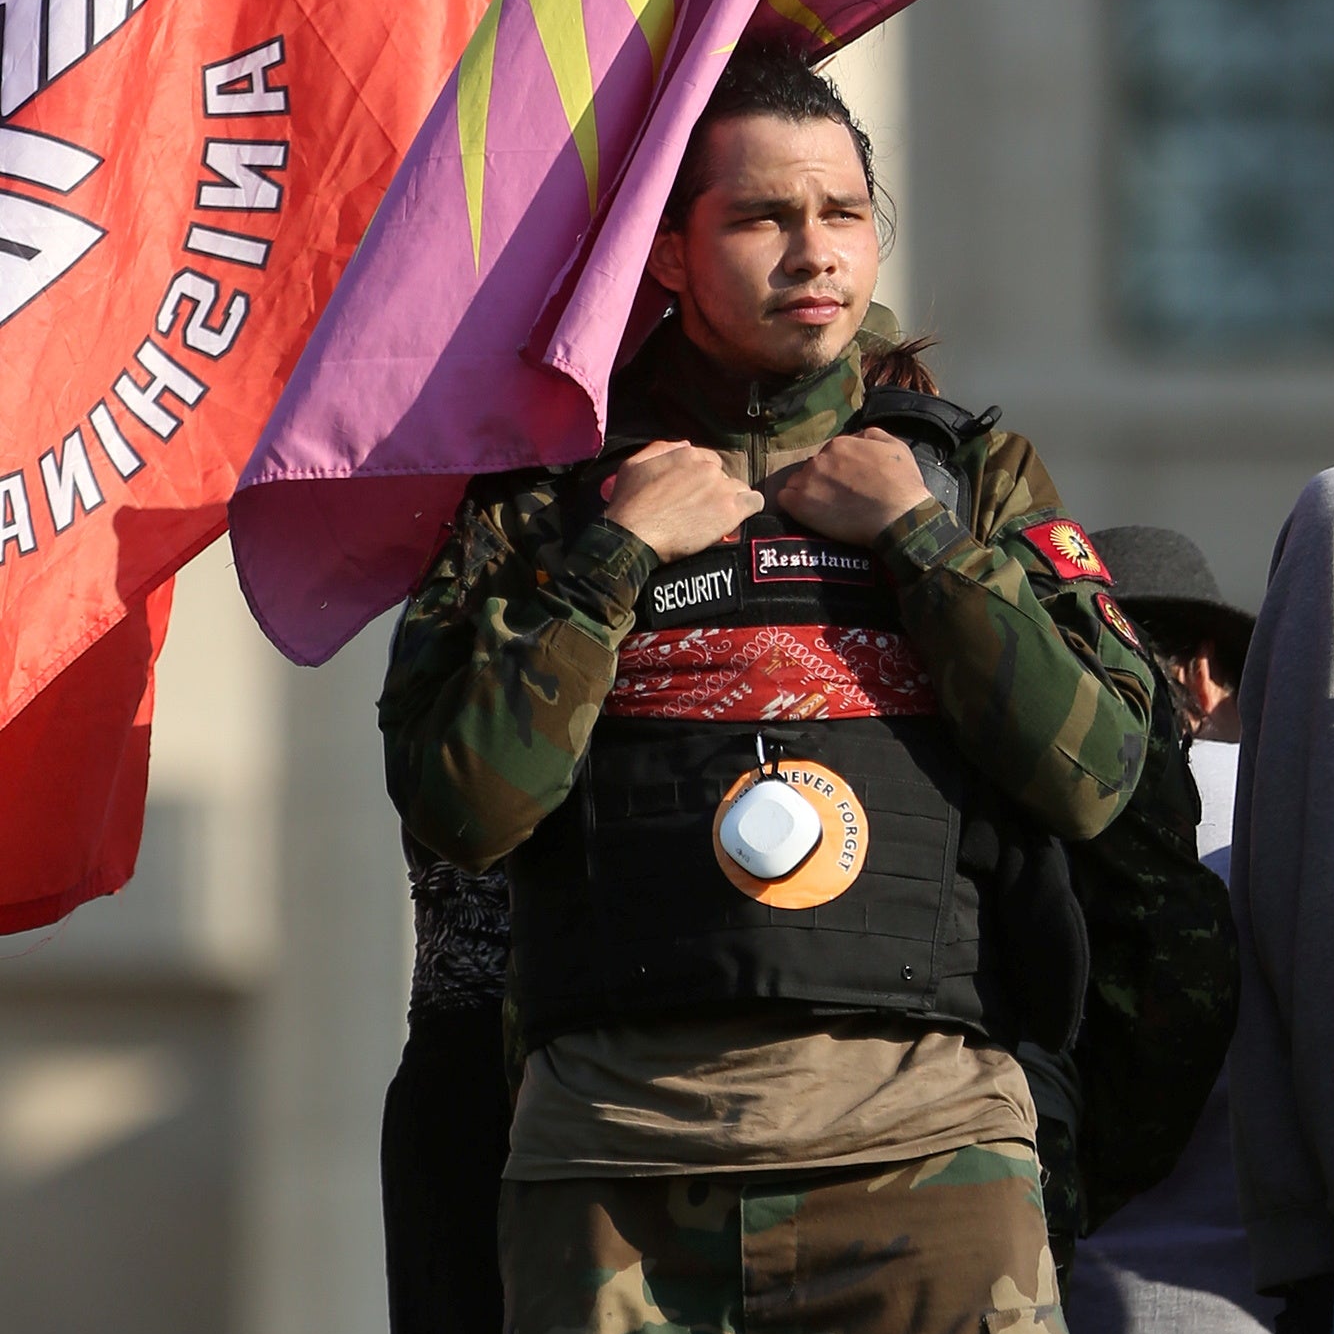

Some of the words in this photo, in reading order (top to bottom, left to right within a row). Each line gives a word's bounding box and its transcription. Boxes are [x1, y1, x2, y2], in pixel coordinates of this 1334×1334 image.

[758, 548, 870, 573] Resistance
[654, 568, 733, 613] SECURITY
[837, 802, 858, 871] FORGET
